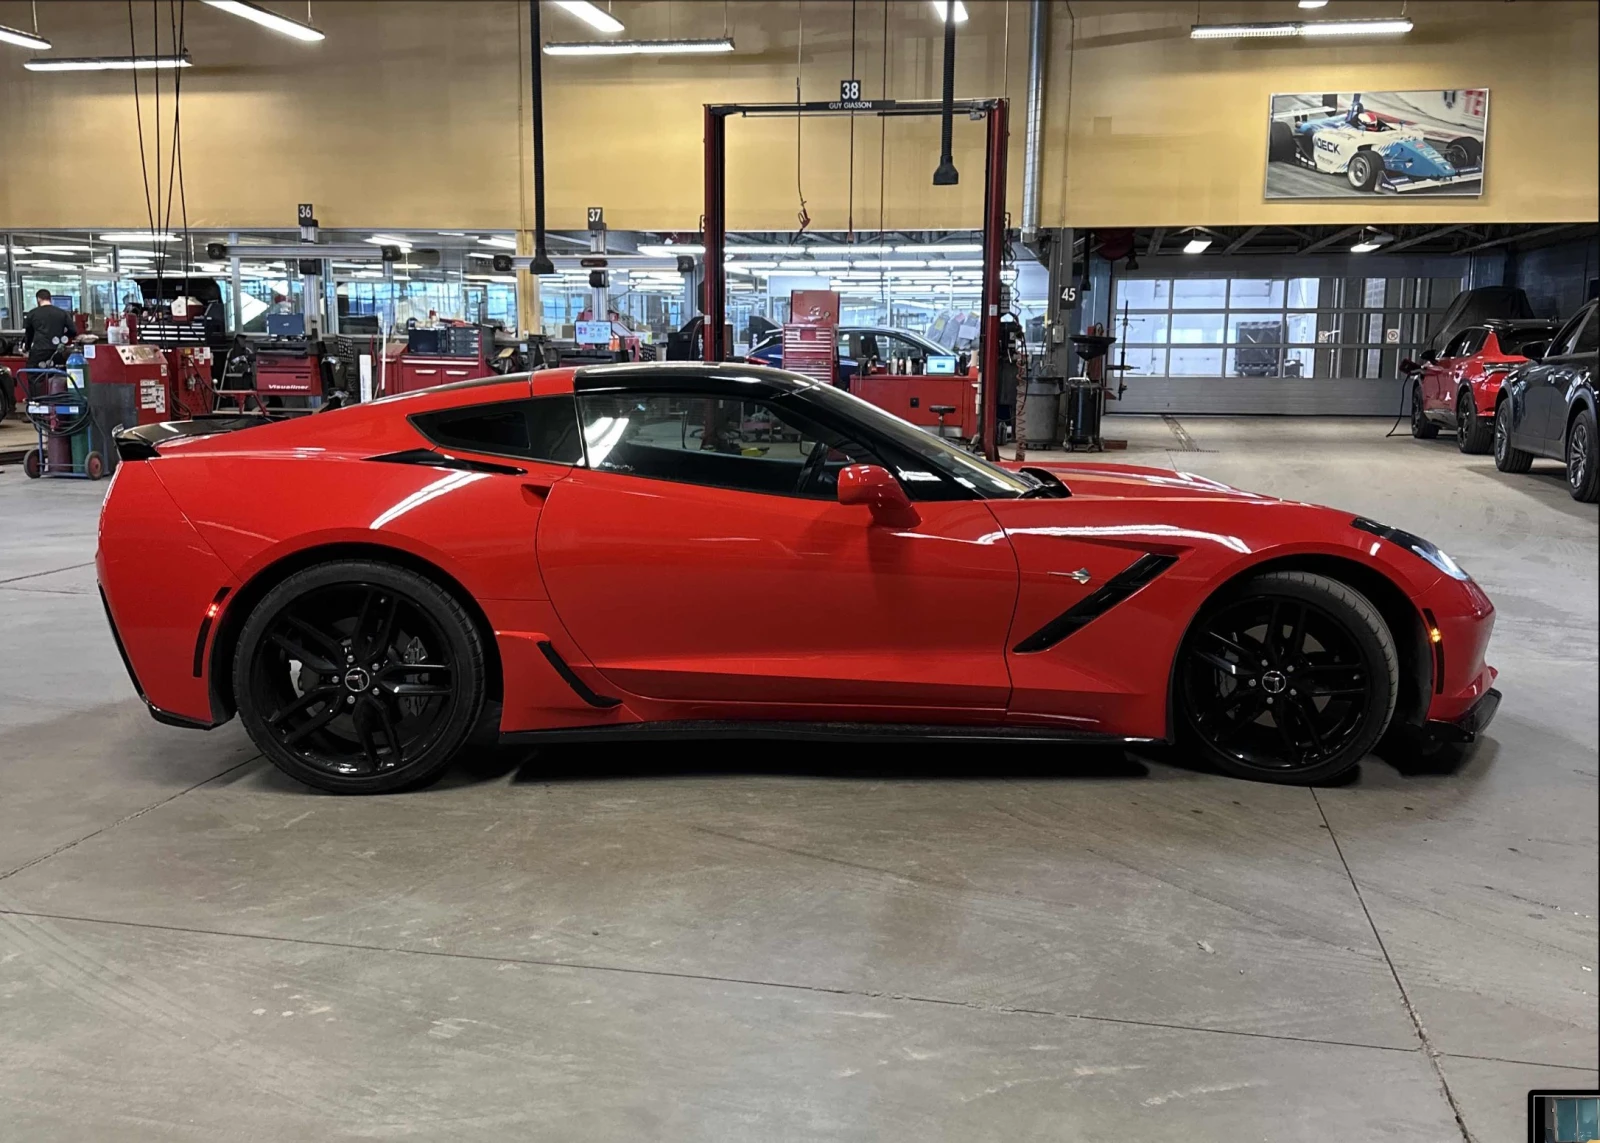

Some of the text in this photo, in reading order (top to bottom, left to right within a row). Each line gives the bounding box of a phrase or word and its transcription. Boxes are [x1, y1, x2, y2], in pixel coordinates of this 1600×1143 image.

[842, 82, 859, 100] 38
[299, 205, 311, 218] 36
[589, 208, 601, 222] 37
[1061, 287, 1076, 301] 45
